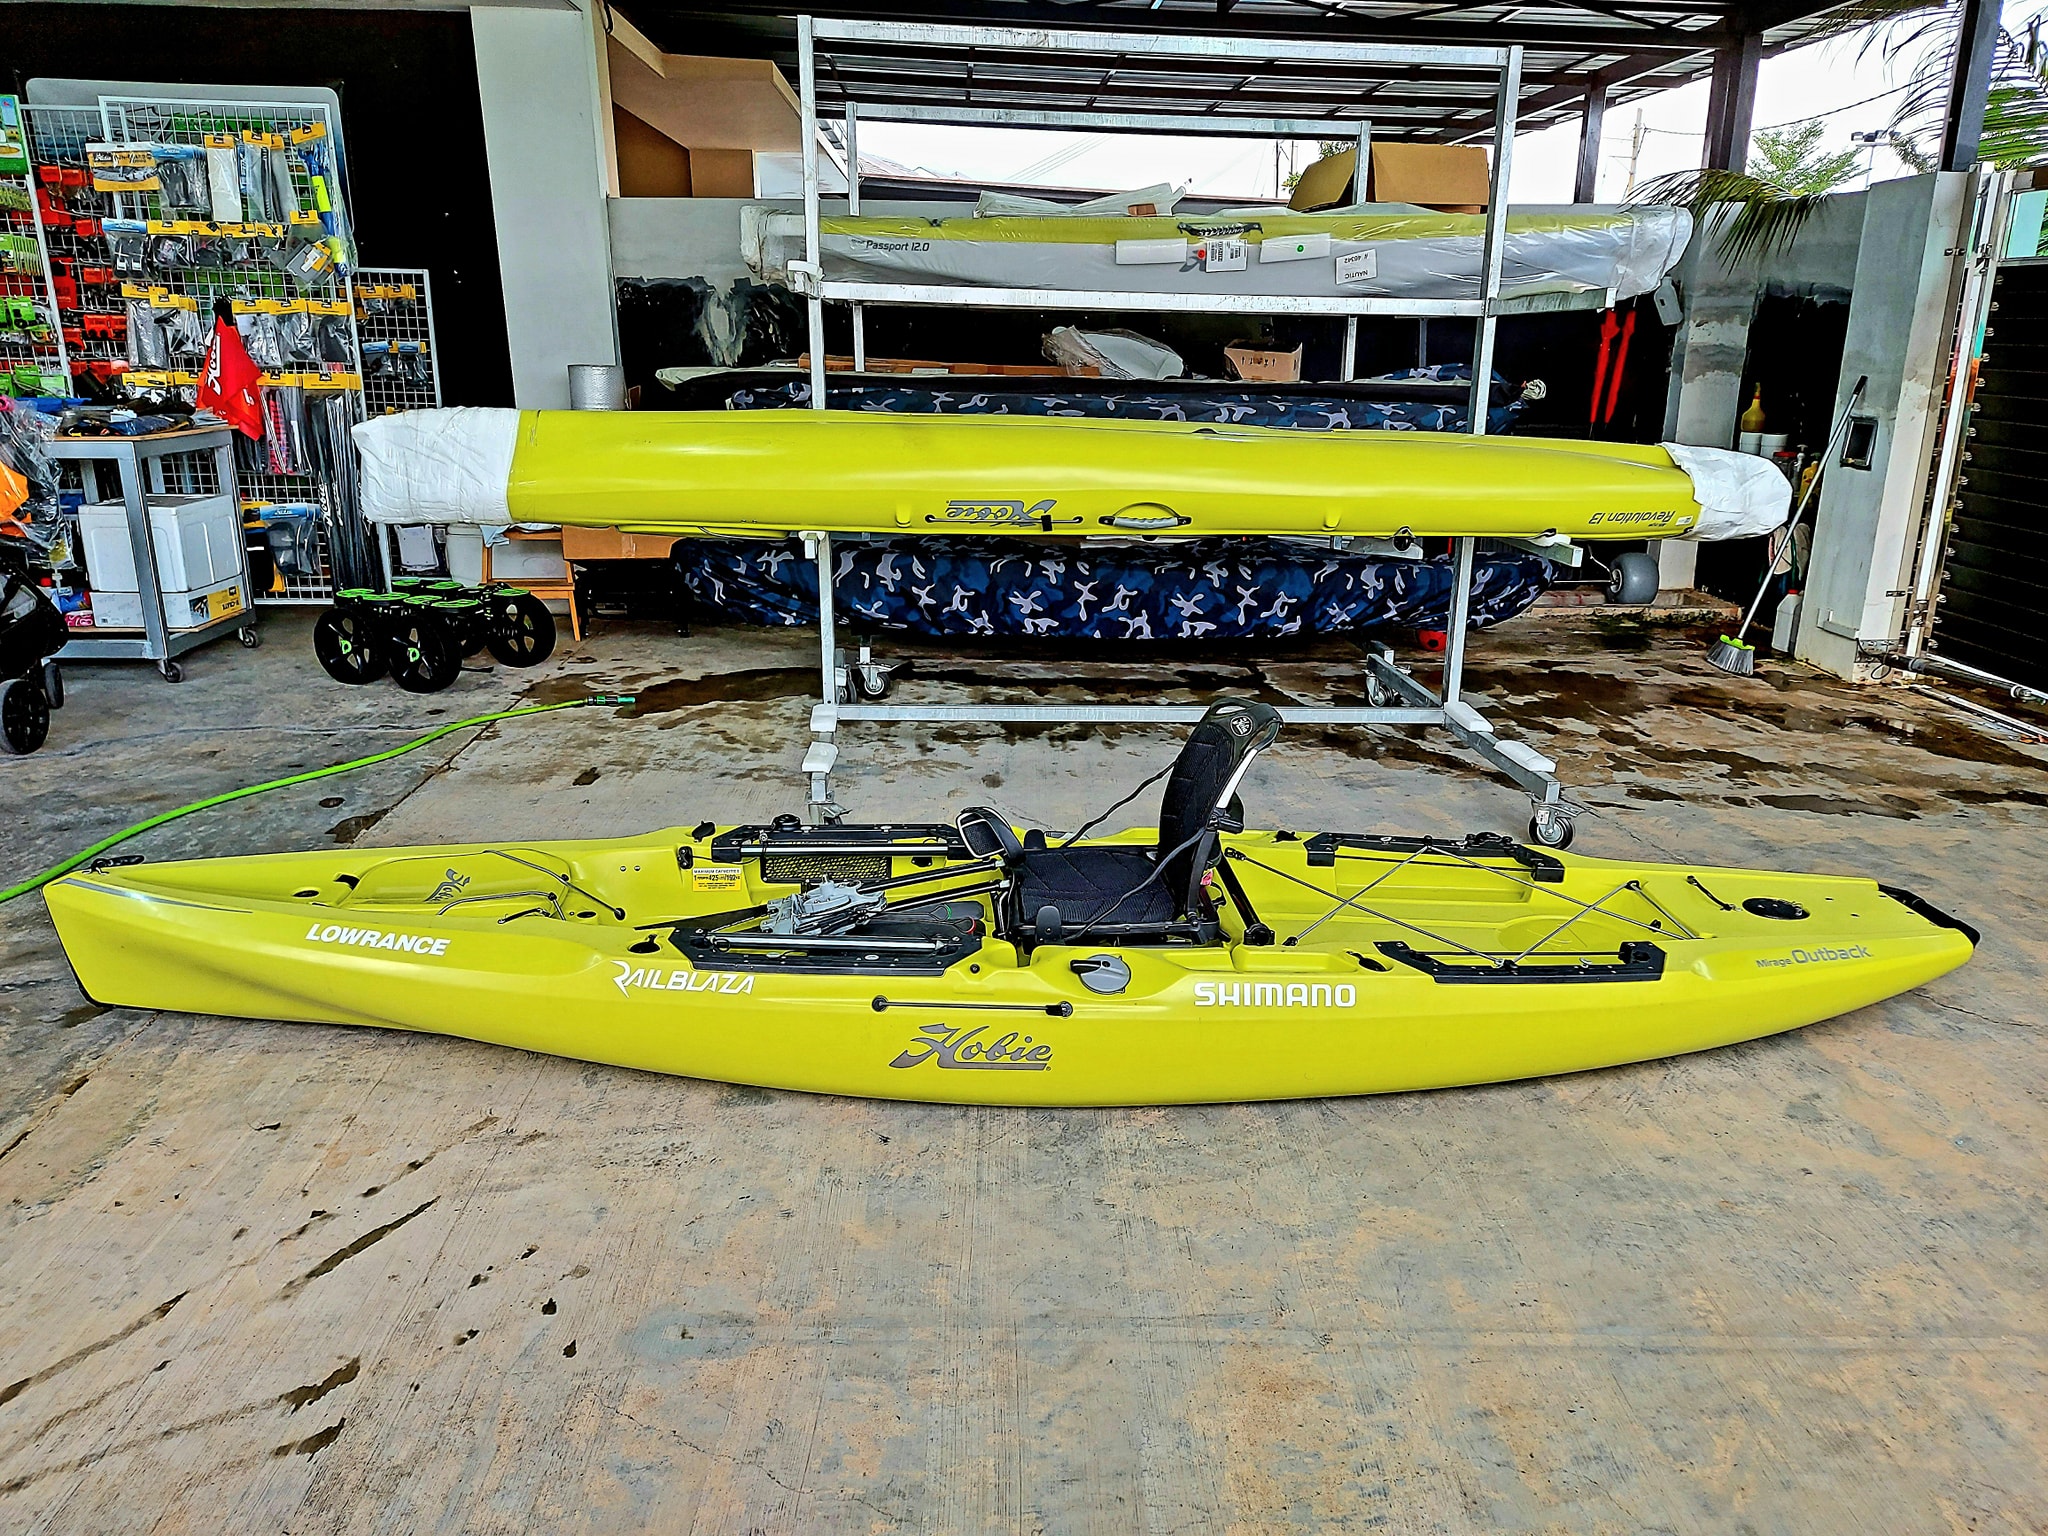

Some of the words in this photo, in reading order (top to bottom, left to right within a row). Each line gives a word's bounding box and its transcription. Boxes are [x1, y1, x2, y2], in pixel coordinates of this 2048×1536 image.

[866, 240, 909, 252] Passport
[911, 242, 930, 252] 12.0
[1344, 270, 1368, 279] NAUTIC
[946, 499, 1057, 527] Hobie
[1588, 512, 1605, 525] 13
[1607, 510, 1676, 525] Revolution
[305, 922, 451, 957] LOWRANCE
[1755, 958, 1792, 968] Mirage
[1791, 944, 1872, 964] Outback
[611, 959, 756, 998] RAILBLAZA
[1193, 981, 1357, 1008] SHIMANO
[888, 1021, 1053, 1071] Hobie
